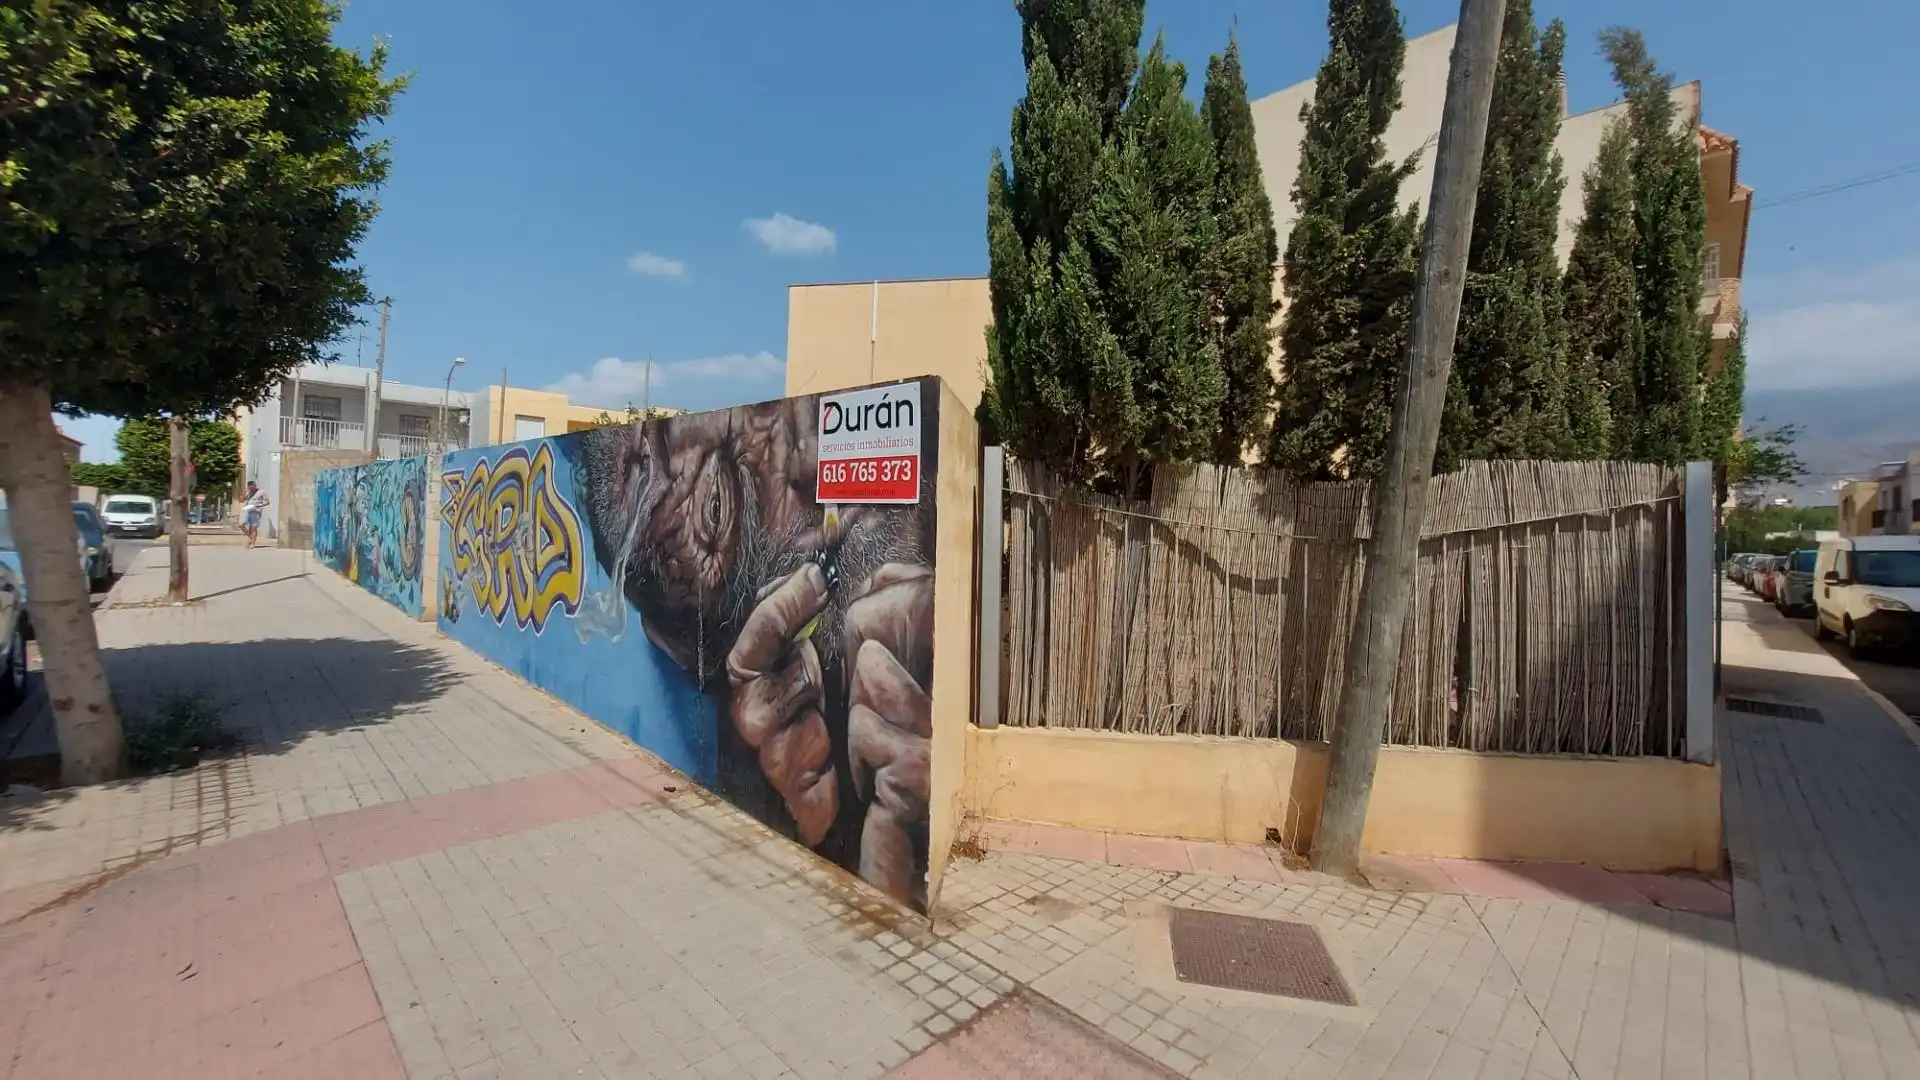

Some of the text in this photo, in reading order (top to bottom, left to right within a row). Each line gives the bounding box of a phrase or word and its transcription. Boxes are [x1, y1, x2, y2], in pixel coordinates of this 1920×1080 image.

[823, 393, 914, 435] Durán
[822, 436, 914, 453] servicios inmobiliarios
[822, 459, 912, 483] 616 765 373
